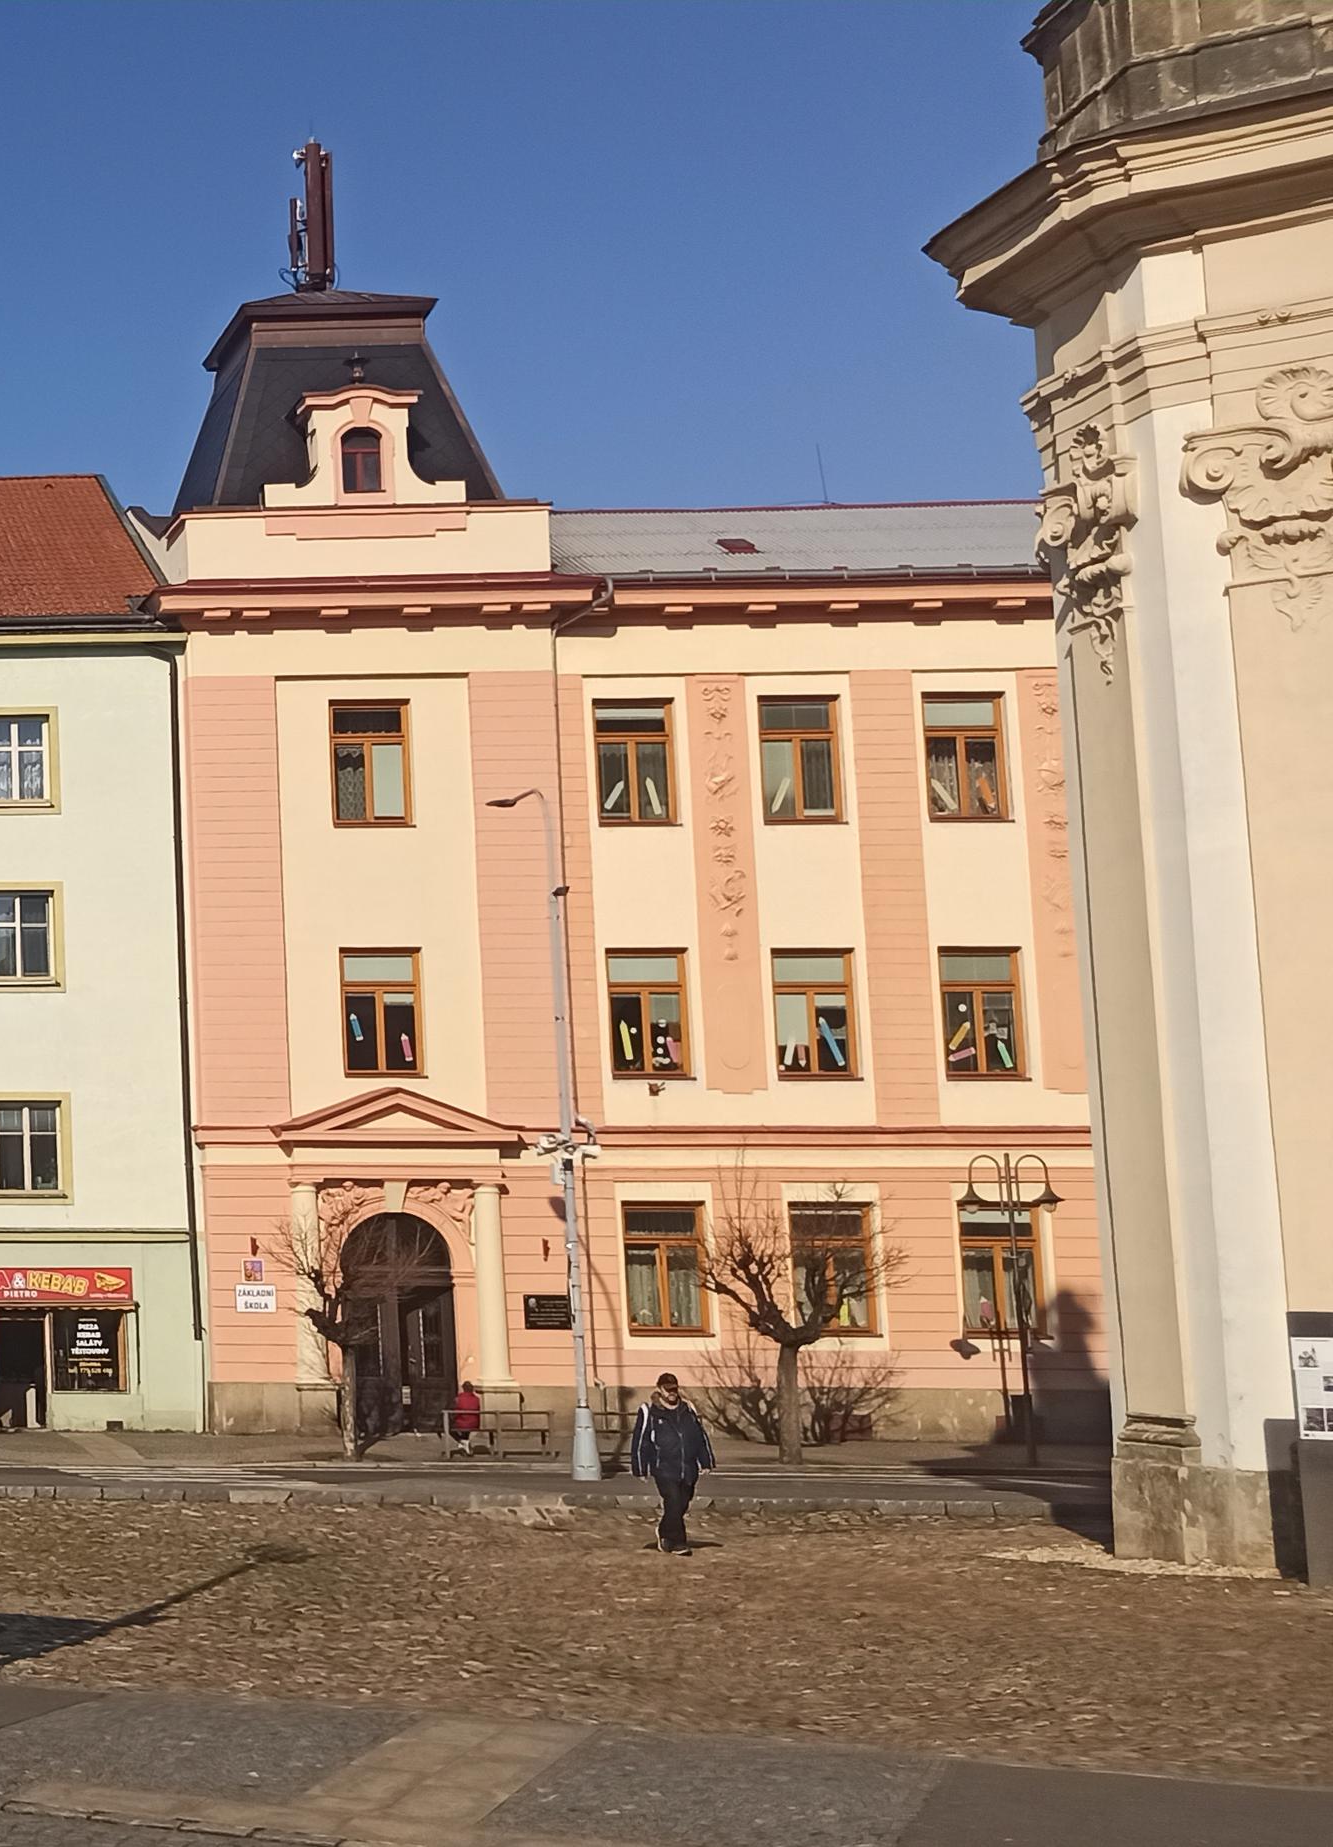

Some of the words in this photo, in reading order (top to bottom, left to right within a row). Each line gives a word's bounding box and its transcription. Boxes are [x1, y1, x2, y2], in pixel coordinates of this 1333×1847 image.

[12, 1272, 26, 1289] &
[26, 1270, 89, 1297] KEBAB
[3, 1290, 38, 1298] PIETRO
[238, 1287, 274, 1297] ZÁKLADNÍ
[244, 1300, 269, 1310] ŠKOLA
